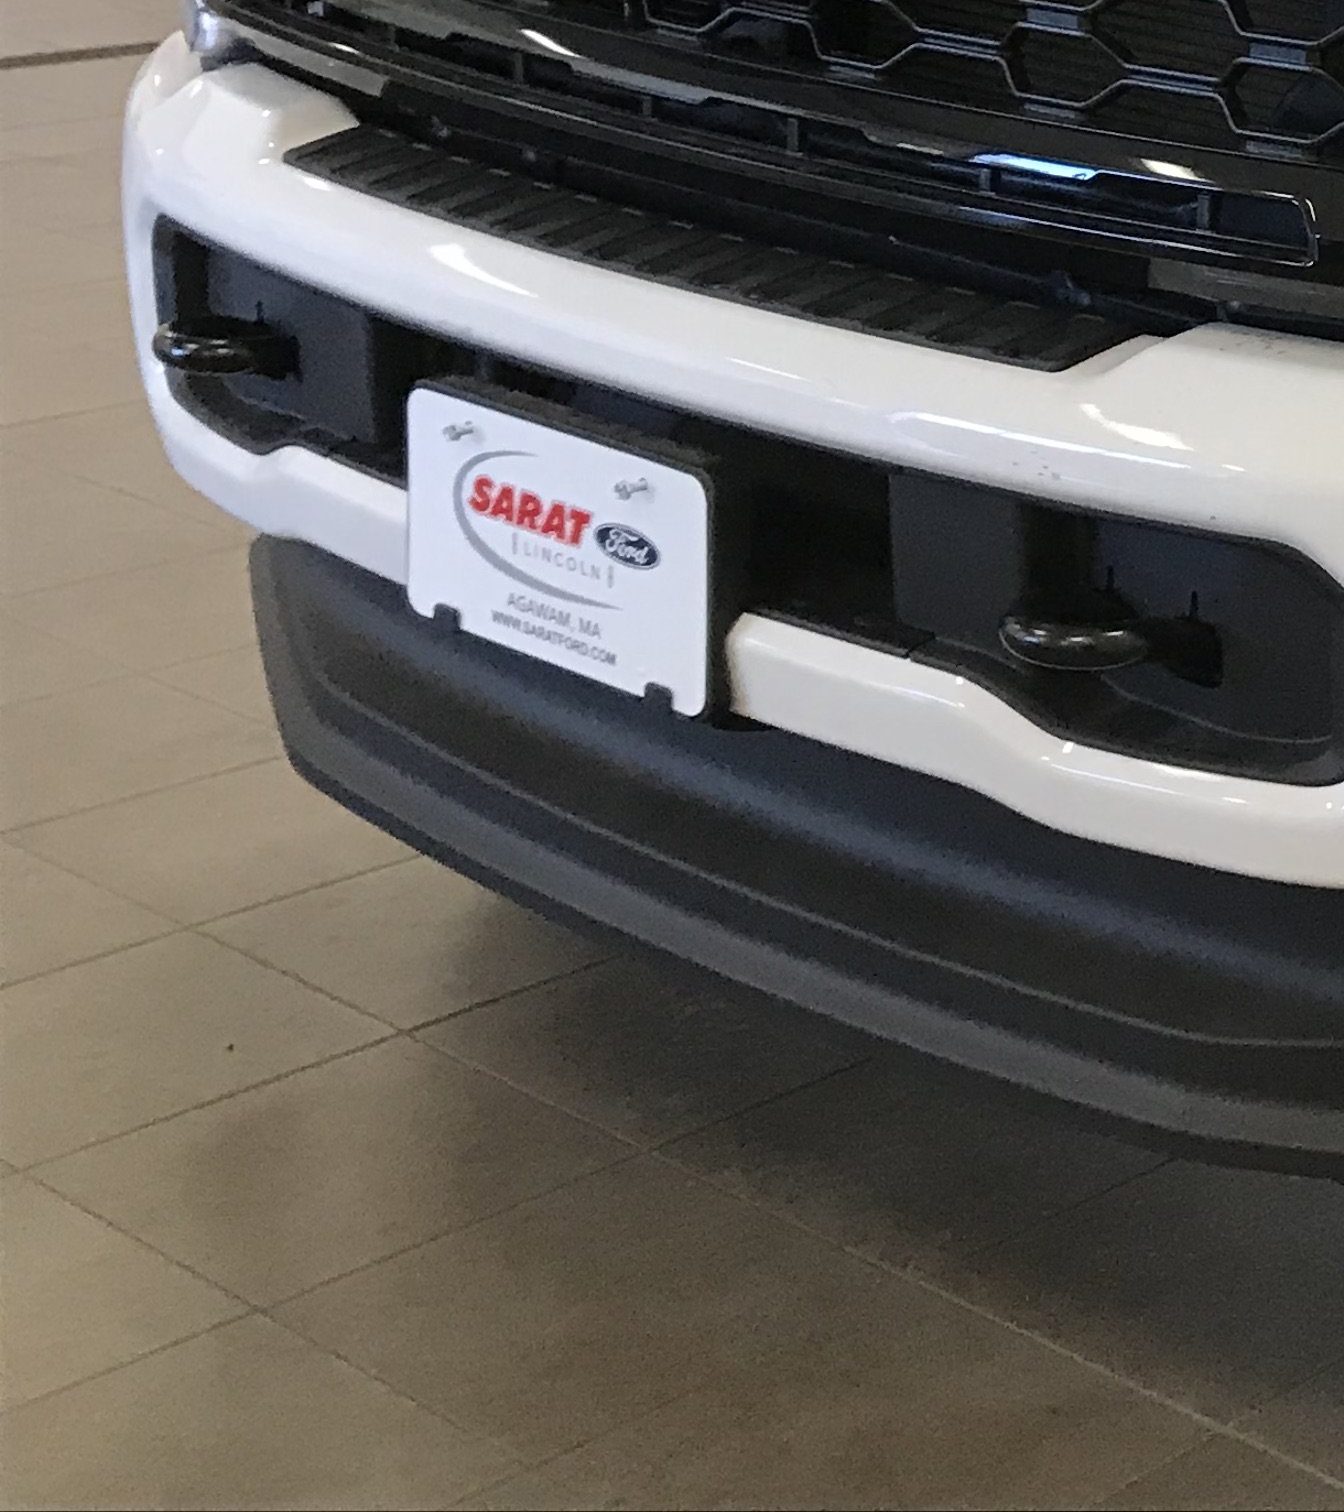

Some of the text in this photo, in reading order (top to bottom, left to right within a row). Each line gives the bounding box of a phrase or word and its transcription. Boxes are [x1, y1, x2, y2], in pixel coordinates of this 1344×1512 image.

[467, 473, 650, 565] SARAT Ford
[523, 541, 601, 580] LINCOLN
[578, 617, 602, 638] MA
